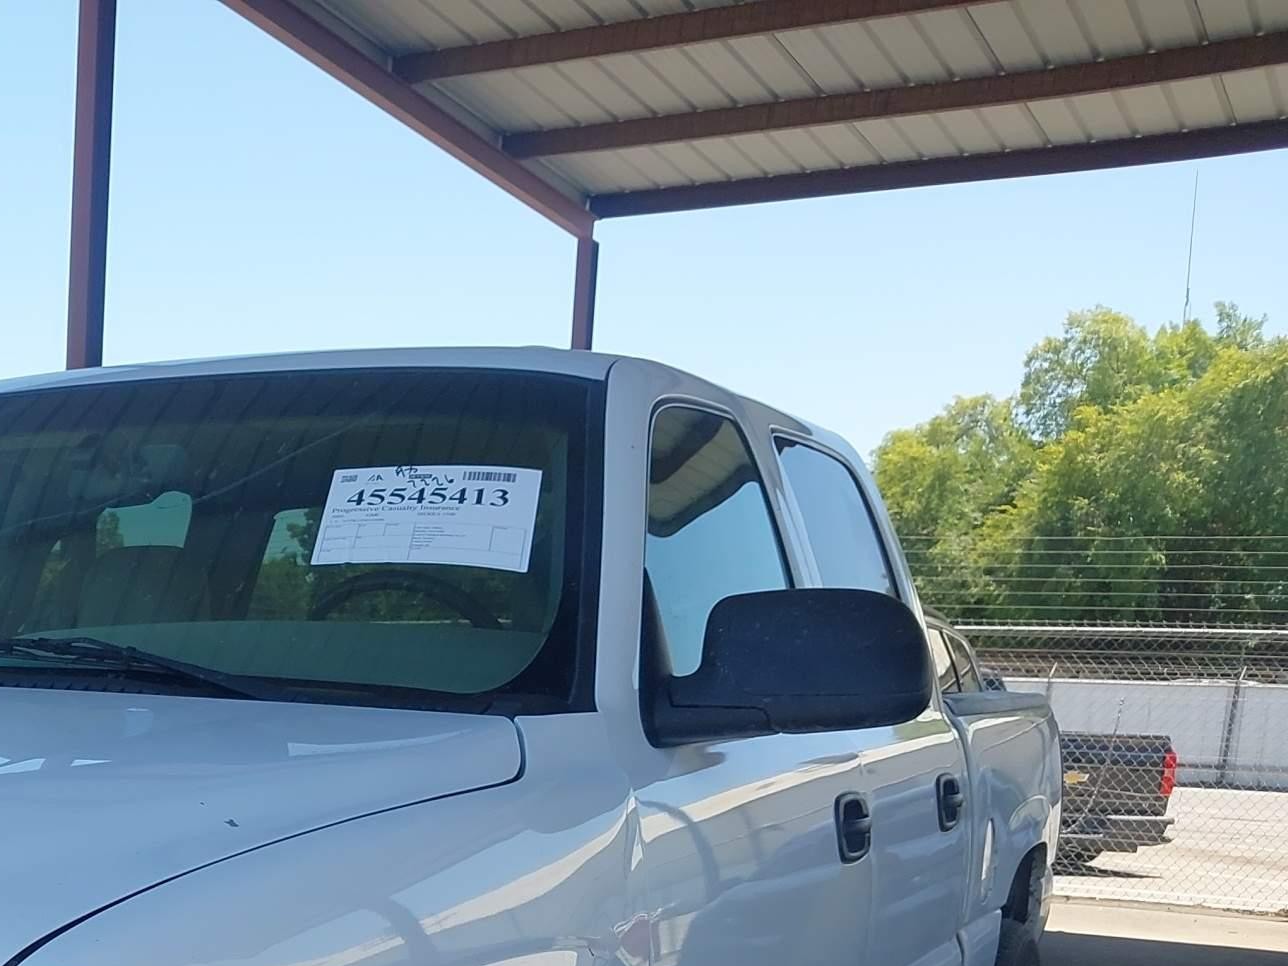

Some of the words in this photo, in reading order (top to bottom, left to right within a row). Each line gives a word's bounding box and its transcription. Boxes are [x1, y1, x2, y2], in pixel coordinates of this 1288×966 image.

[346, 487, 510, 507] 45545413
[331, 505, 380, 514] Progressive
[381, 504, 417, 512] Casualty
